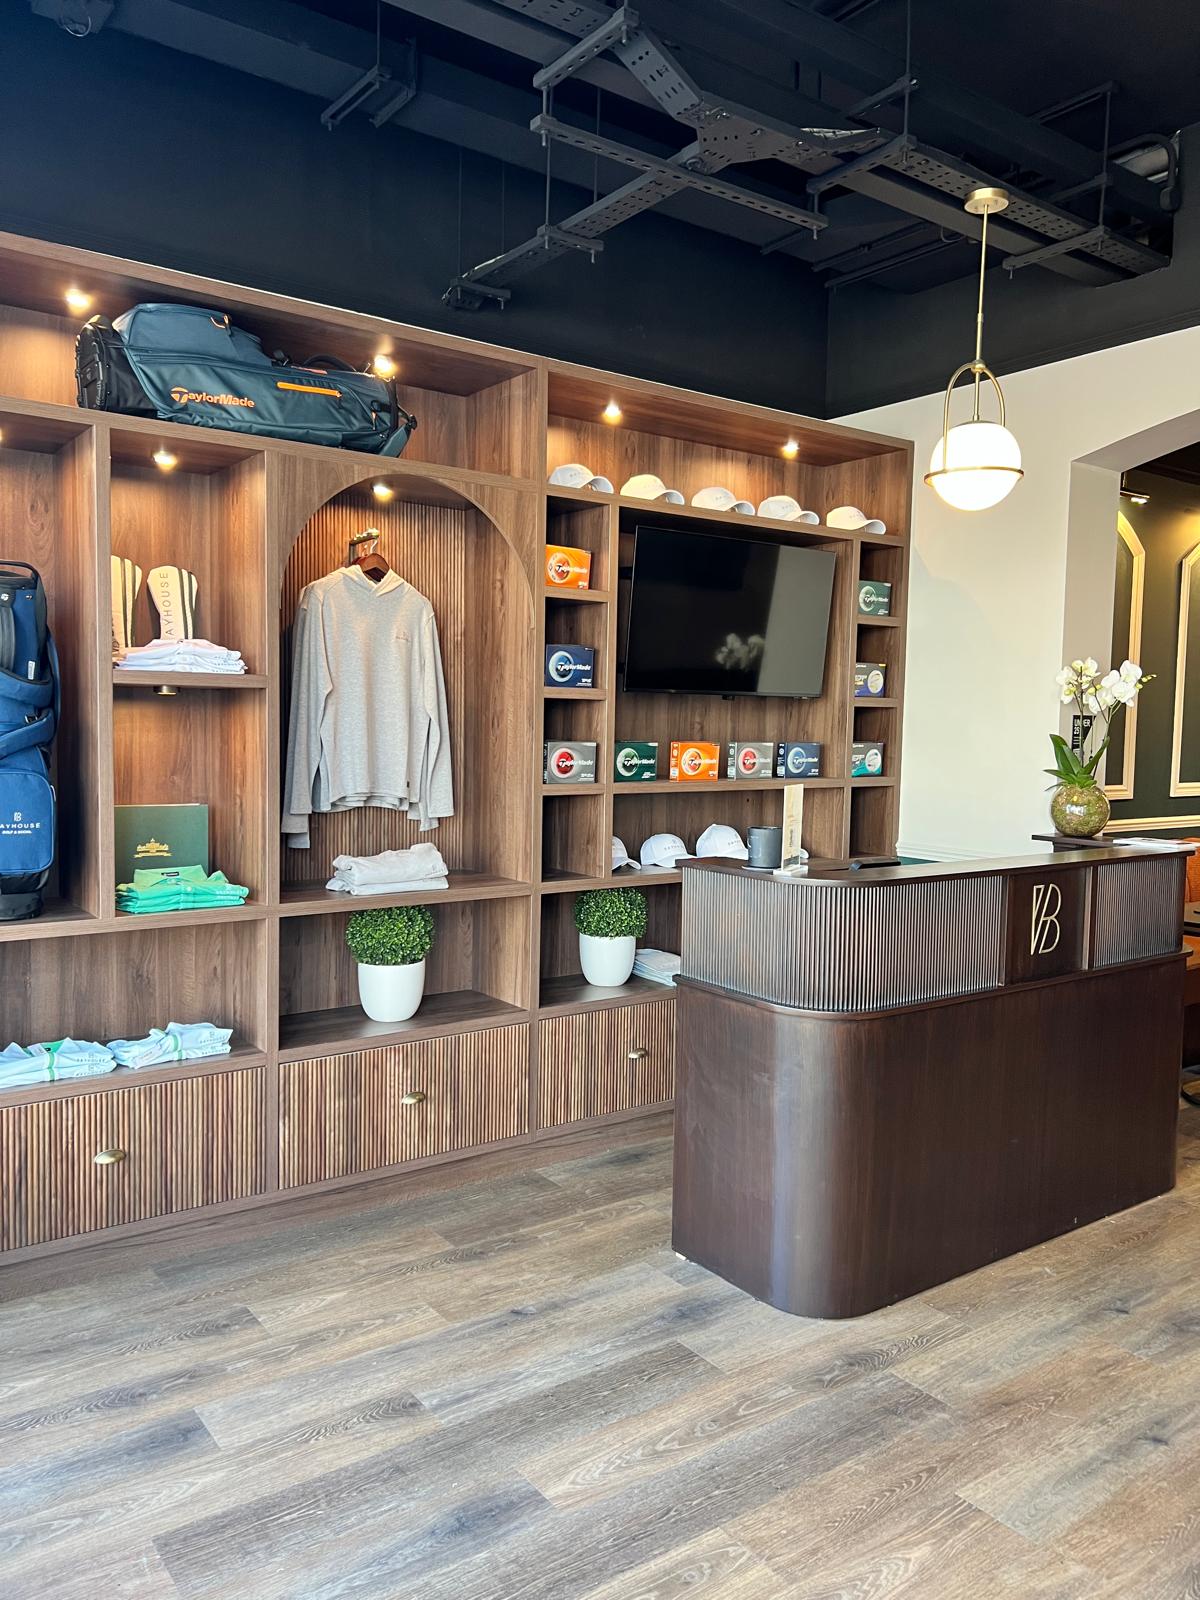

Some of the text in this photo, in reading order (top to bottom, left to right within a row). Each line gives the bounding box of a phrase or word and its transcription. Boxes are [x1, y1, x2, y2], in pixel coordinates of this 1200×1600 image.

[170, 386, 256, 408] TaylorMade
[160, 572, 177, 637] AYHOUSE
[557, 662, 592, 672] TaylorMade
